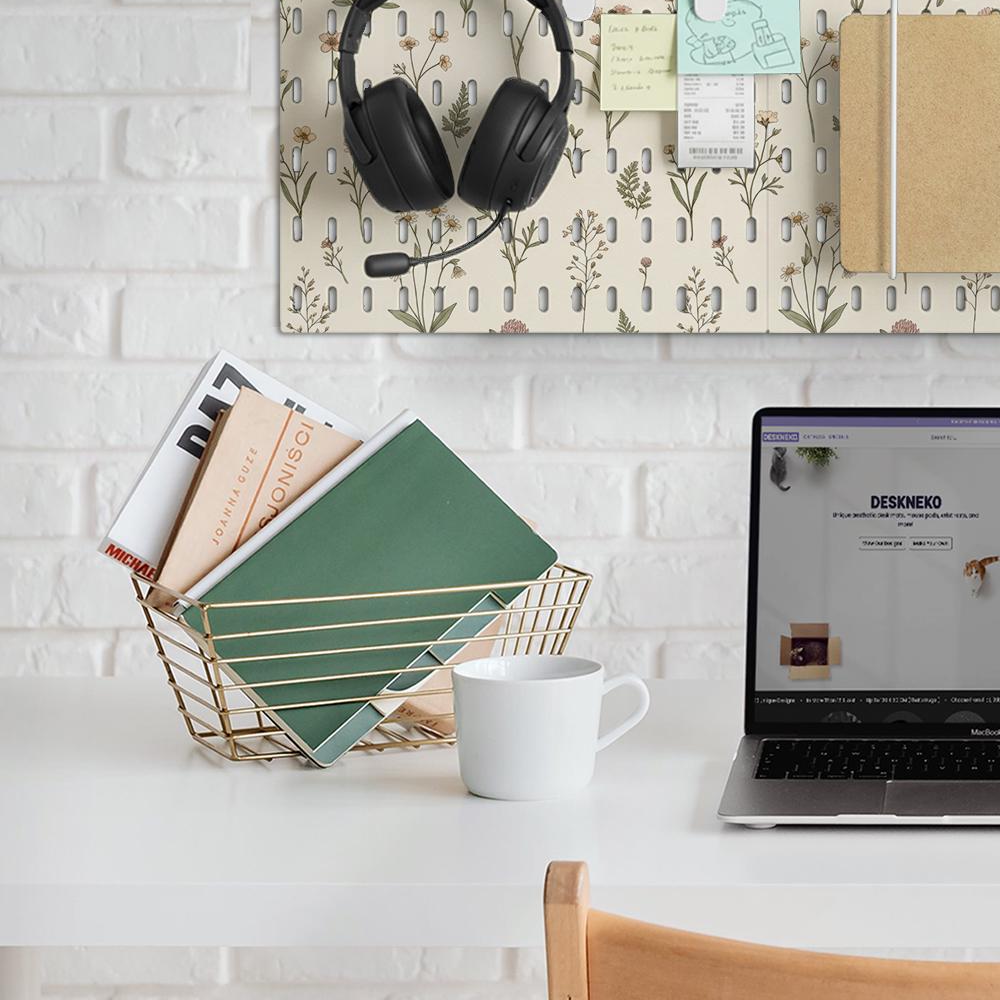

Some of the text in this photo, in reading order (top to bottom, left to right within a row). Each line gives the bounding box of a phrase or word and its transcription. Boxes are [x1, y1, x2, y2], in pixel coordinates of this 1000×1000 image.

[211, 447, 258, 546] JOANNA GUZE
[871, 495, 942, 509] DESKNEKO
